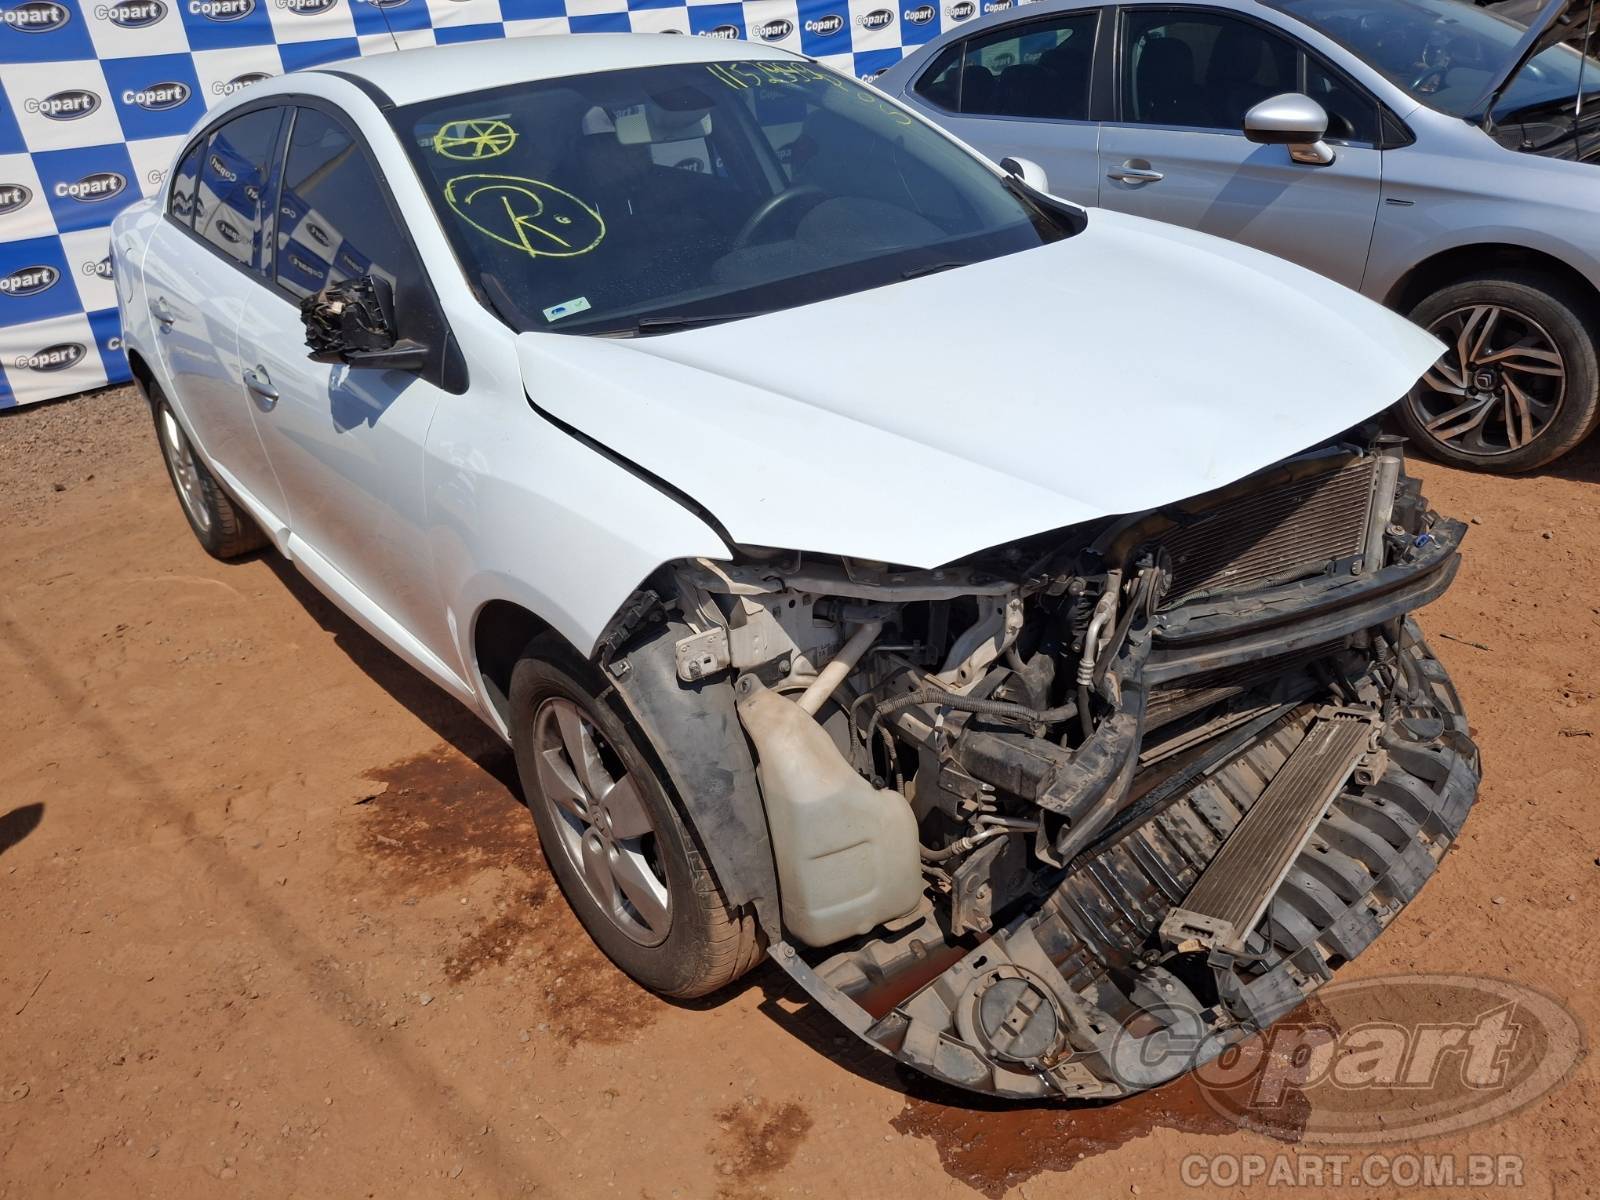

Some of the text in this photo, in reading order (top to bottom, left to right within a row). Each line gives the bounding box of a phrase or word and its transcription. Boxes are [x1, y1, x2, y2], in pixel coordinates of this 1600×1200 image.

[0, 6, 60, 26] opart
[94, 3, 157, 22] Copart
[188, 0, 247, 16] Copart
[904, 8, 931, 22] Copart
[945, 5, 972, 19] Copart
[805, 17, 839, 33] Copart
[856, 12, 889, 27] Copart
[752, 23, 787, 38] Copart
[122, 86, 183, 107] Copart
[24, 95, 90, 116] Copart
[55, 177, 117, 197] Copart
[15, 346, 77, 369] Copart
